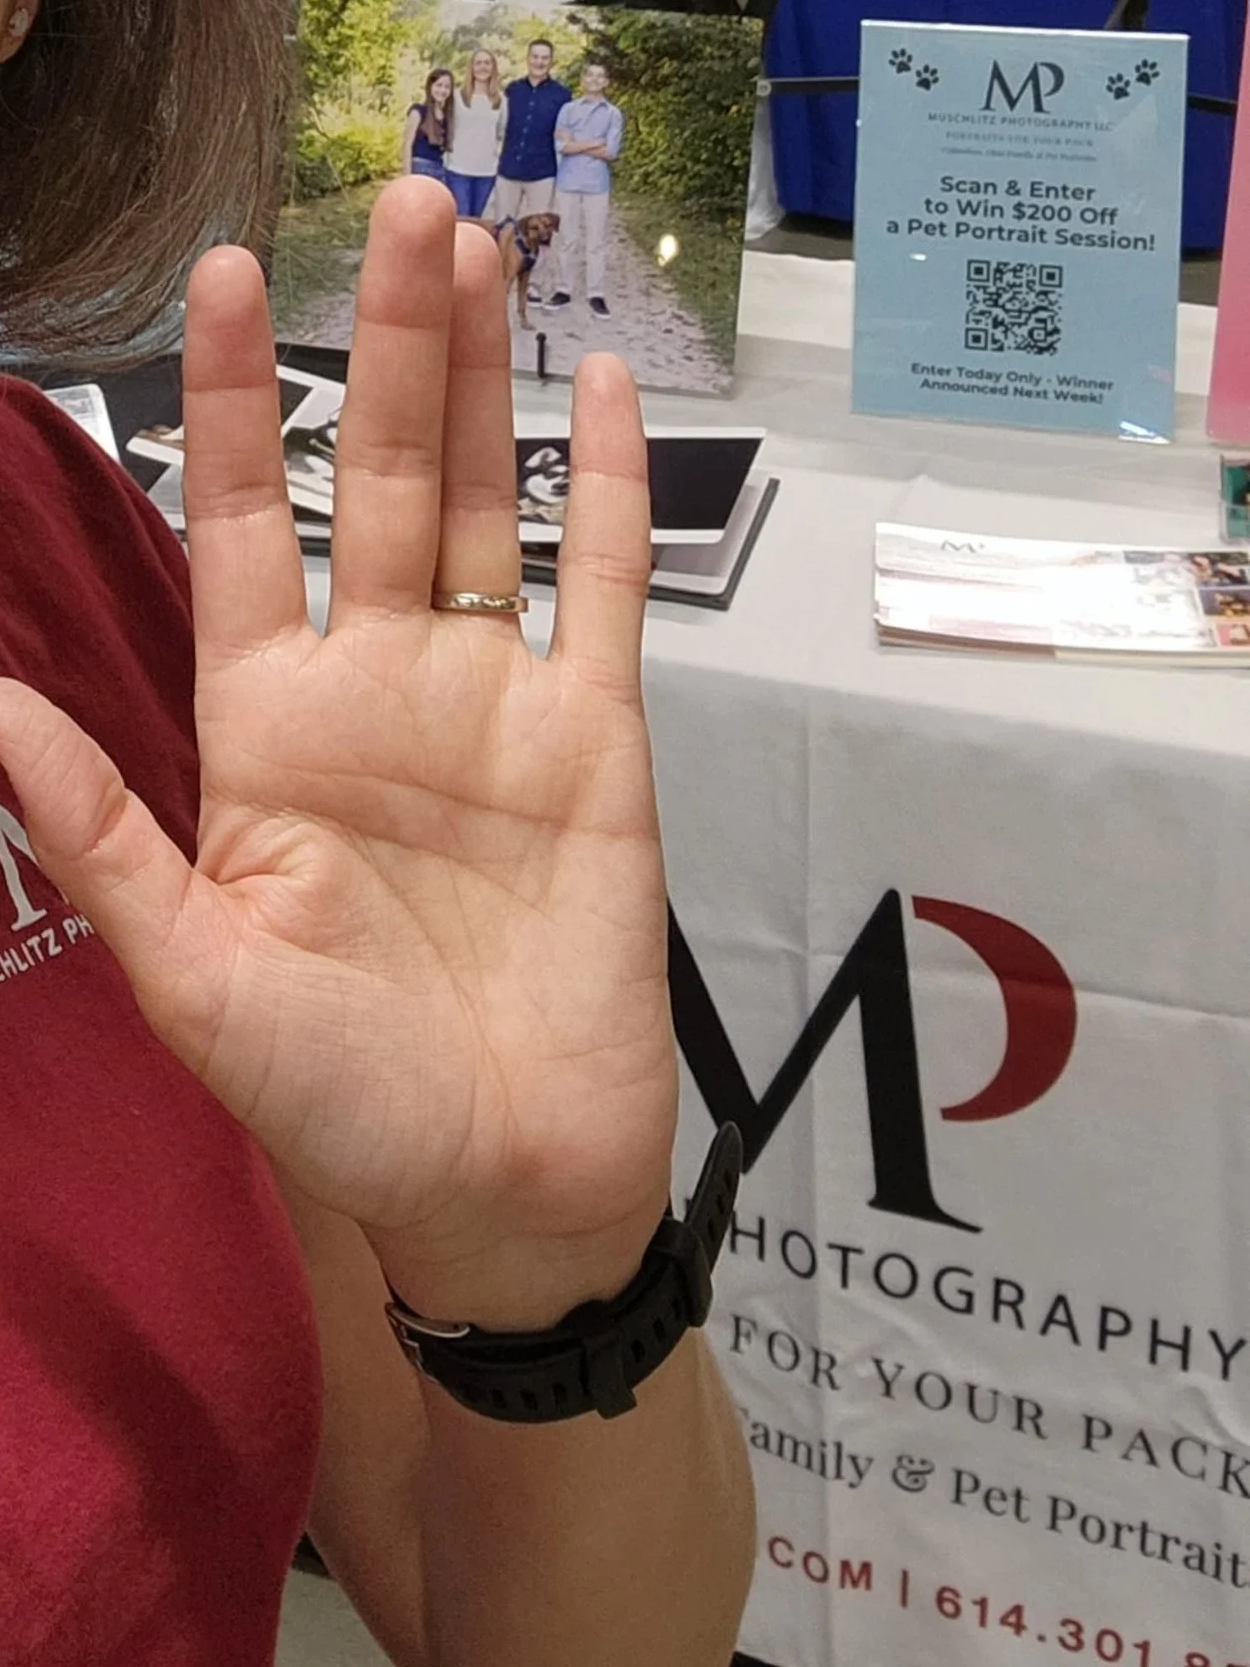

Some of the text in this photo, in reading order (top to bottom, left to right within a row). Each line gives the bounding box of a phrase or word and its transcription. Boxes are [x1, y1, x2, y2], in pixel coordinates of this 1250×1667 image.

[978, 59, 1065, 115] MP
[928, 112, 997, 127] MUSCHLITZ
[1000, 117, 1092, 131] PHOTOGRAPHY
[940, 176, 1096, 202] Scan & Enter
[924, 198, 1118, 226] to Win $200 Off
[886, 218, 1156, 252] a Pet Portrait Session!
[911, 362, 952, 377] Enter
[957, 366, 1002, 383] Today
[1006, 371, 1042, 387] Only
[1056, 374, 1114, 392] Winner
[920, 377, 1104, 405] Announced Next Week!
[686, 1197, 1248, 1382] HOTOGRAPHY
[729, 1313, 1250, 1500] FOR YOUR PACK
[740, 1408, 1250, 1589] amily & Pet Portrait
[767, 1536, 874, 1593] COM
[936, 1586, 1250, 1667] 614.301
